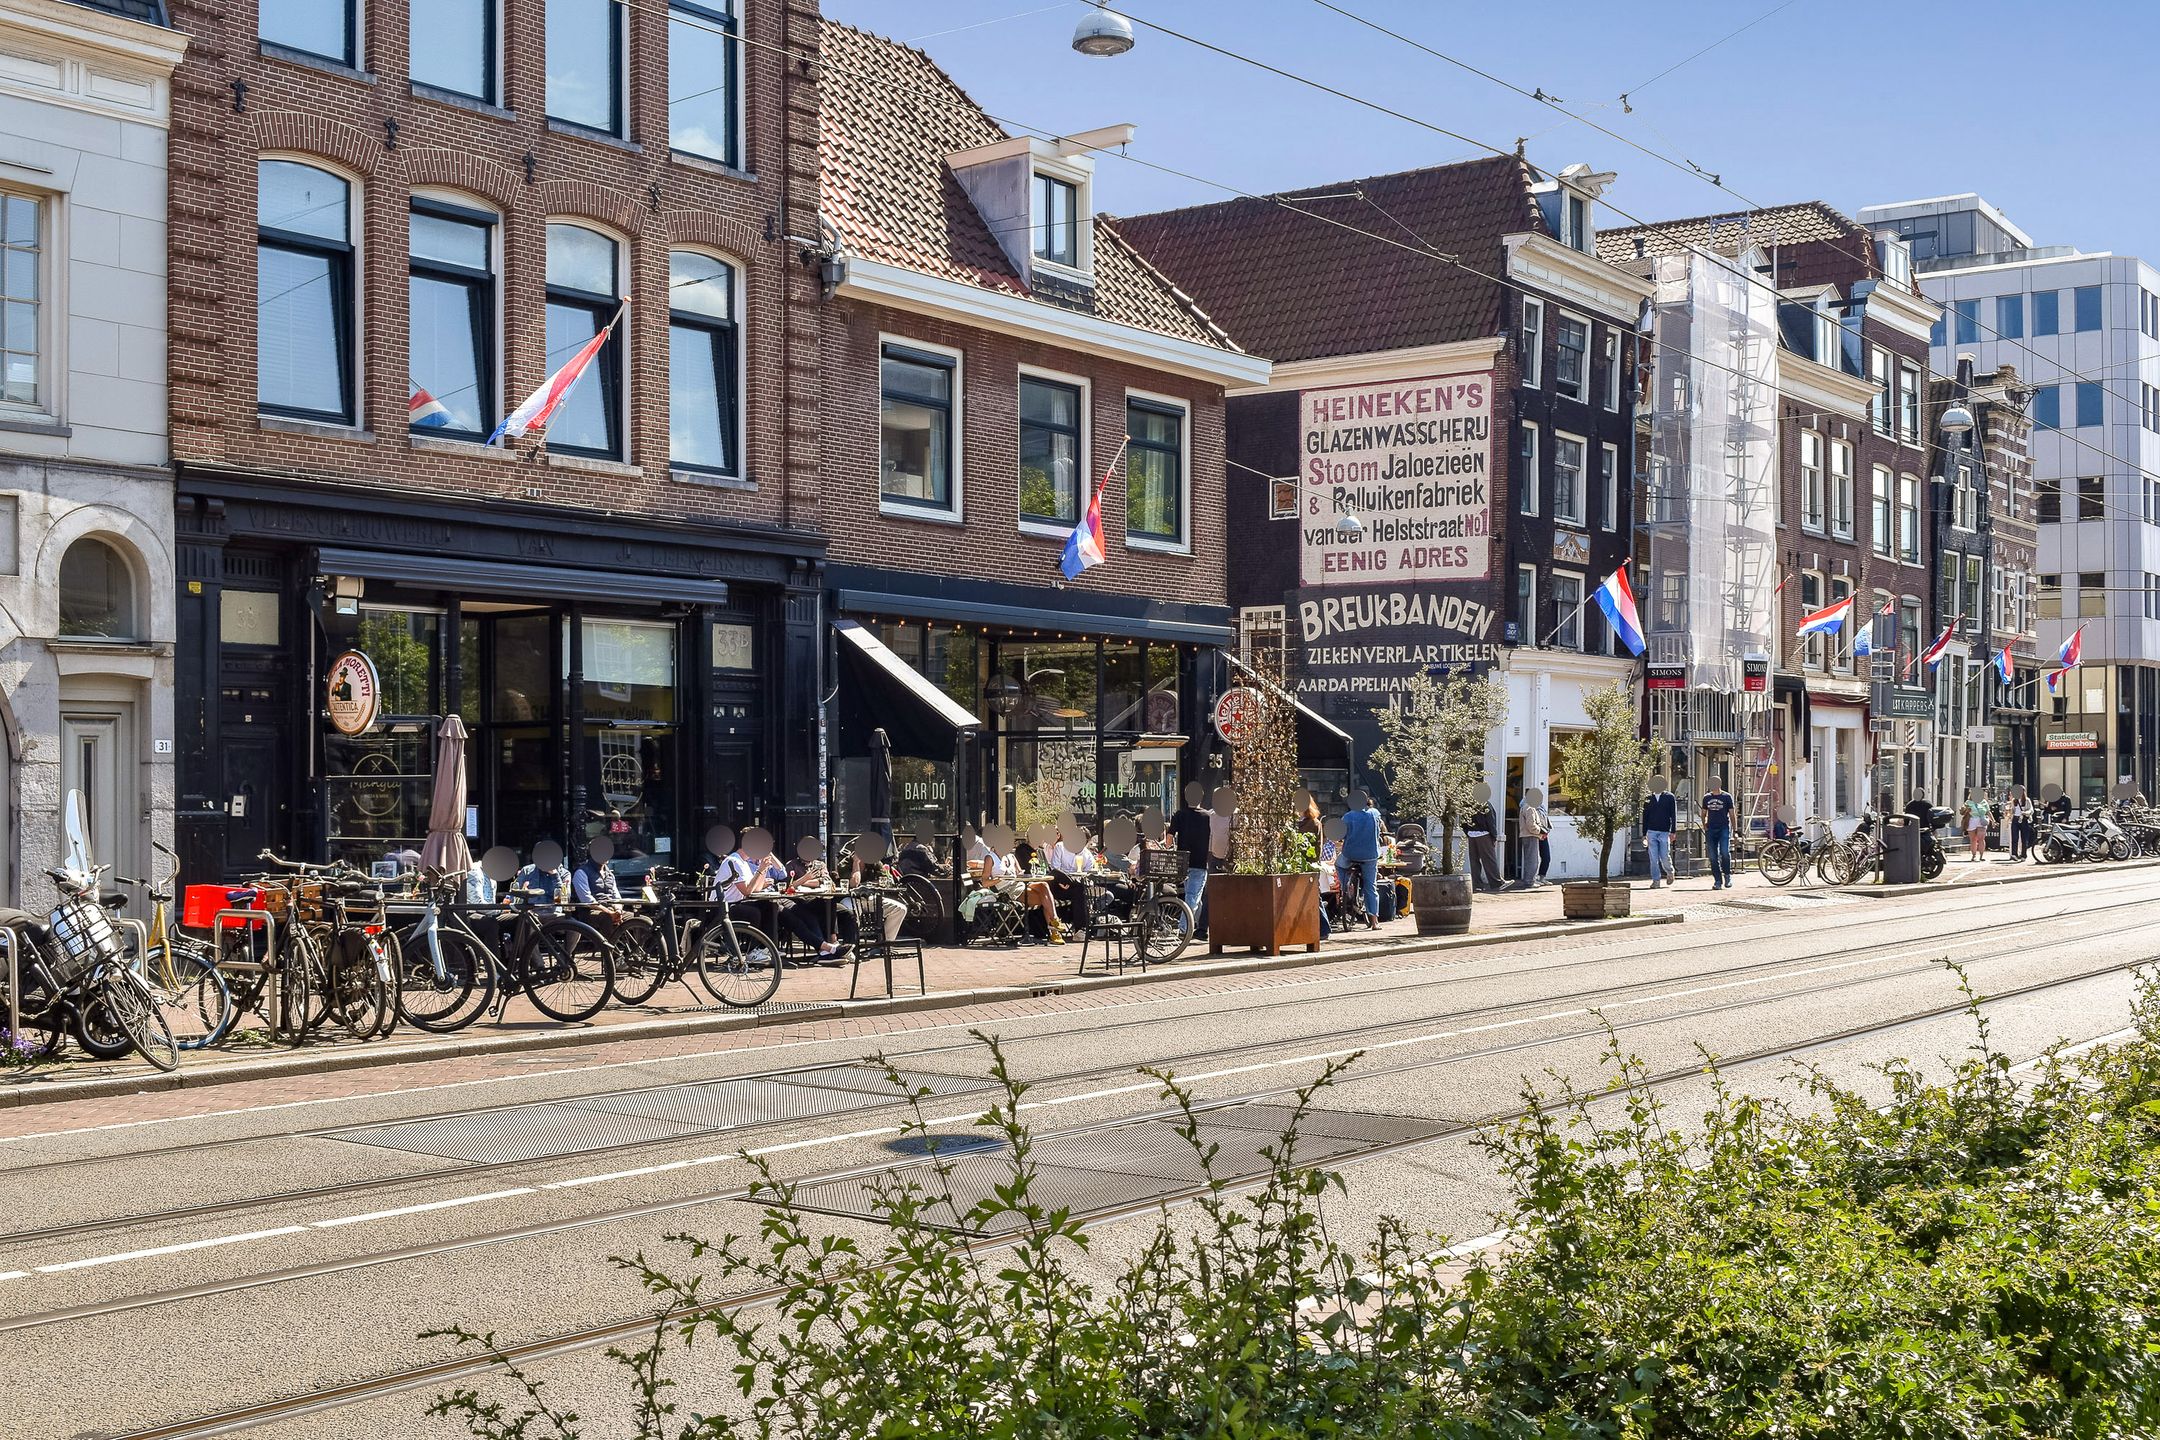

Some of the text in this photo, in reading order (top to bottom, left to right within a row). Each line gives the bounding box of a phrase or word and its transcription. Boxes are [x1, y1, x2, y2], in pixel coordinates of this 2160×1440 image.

[1313, 383, 1484, 424] HEINEKEN'S
[1308, 447, 1484, 485] Stoom Jaloezieën
[1309, 478, 1486, 515] & Rolluikenfabriek
[1372, 514, 1464, 543] Helststraat
[1323, 545, 1469, 573] EENIG ADRES
[1299, 592, 1496, 643] BREUKBANDEN
[344, 657, 371, 697] MORETTI
[1296, 676, 1432, 693] AARDAPPELHAN
[157, 741, 169, 751] 31
[2050, 740, 2095, 748] Retourshop
[1208, 753, 1223, 769] 35
[905, 779, 946, 800] BAR DÓ
[1128, 782, 1147, 798] BAR
